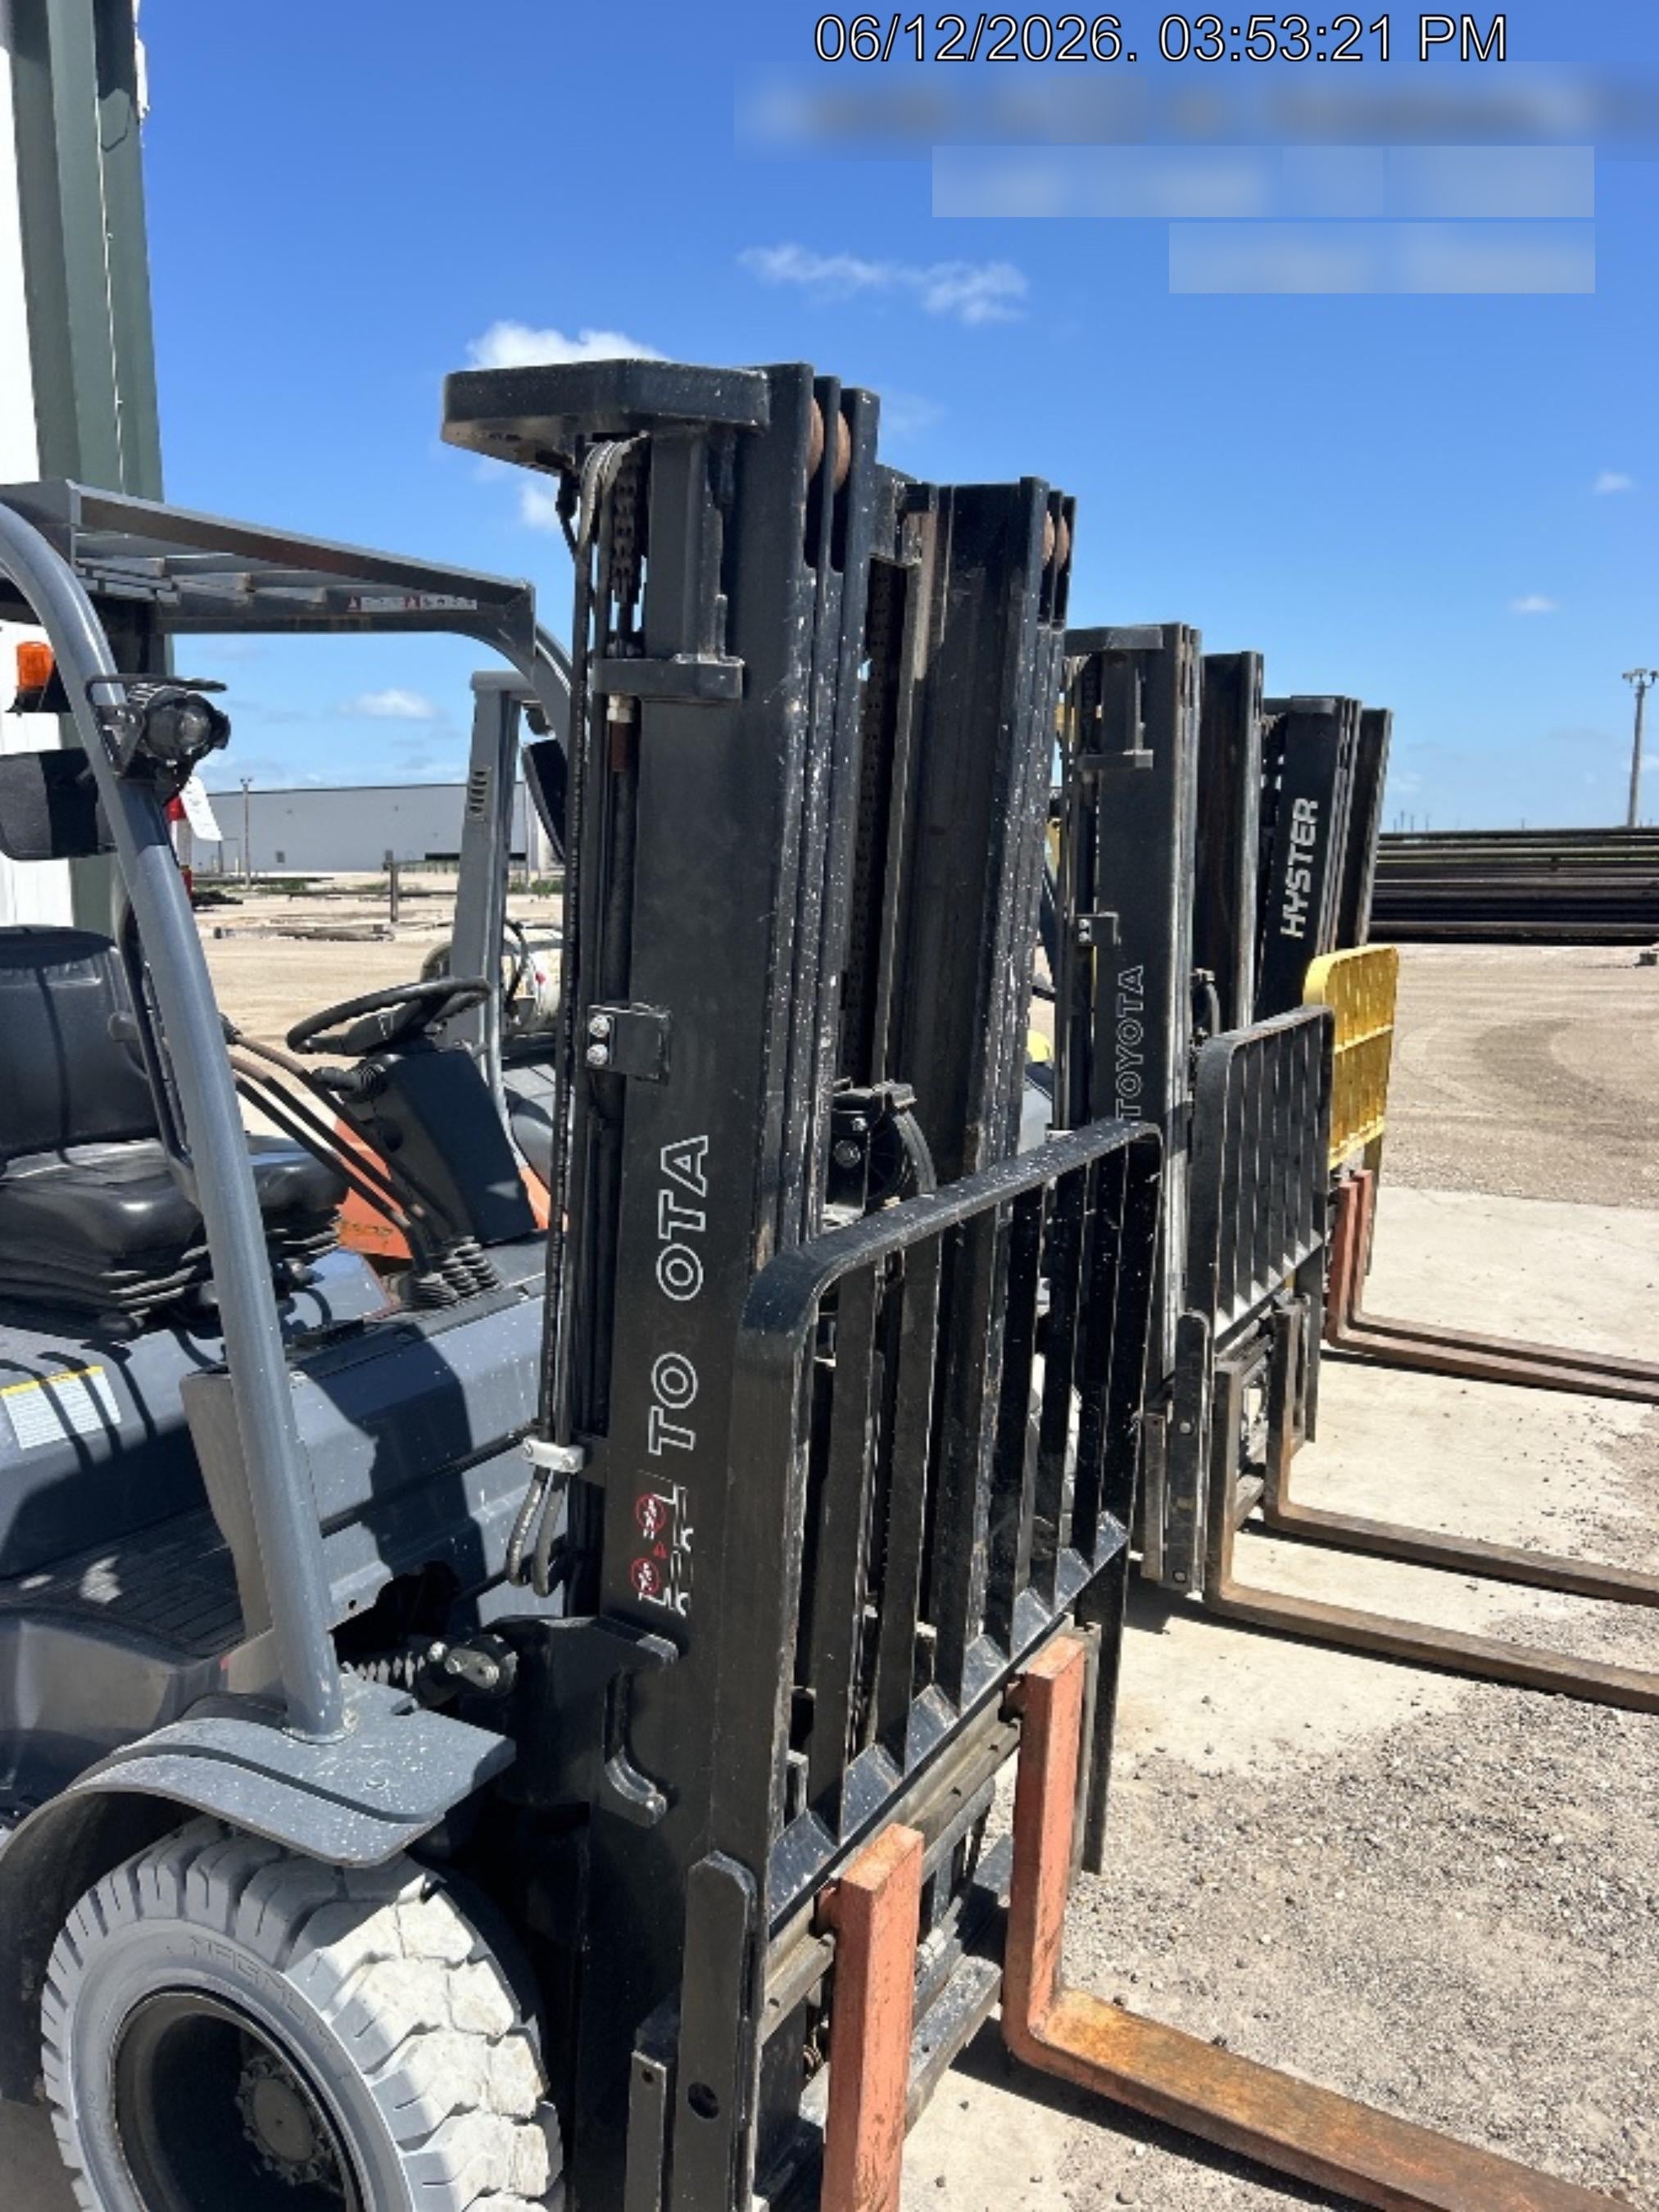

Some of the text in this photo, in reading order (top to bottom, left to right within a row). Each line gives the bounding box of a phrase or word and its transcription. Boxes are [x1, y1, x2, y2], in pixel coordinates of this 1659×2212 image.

[1280, 797, 1318, 939] HYSTER
[1115, 963, 1145, 1122] TOYOTA
[648, 1135, 709, 1456] TOOTA
